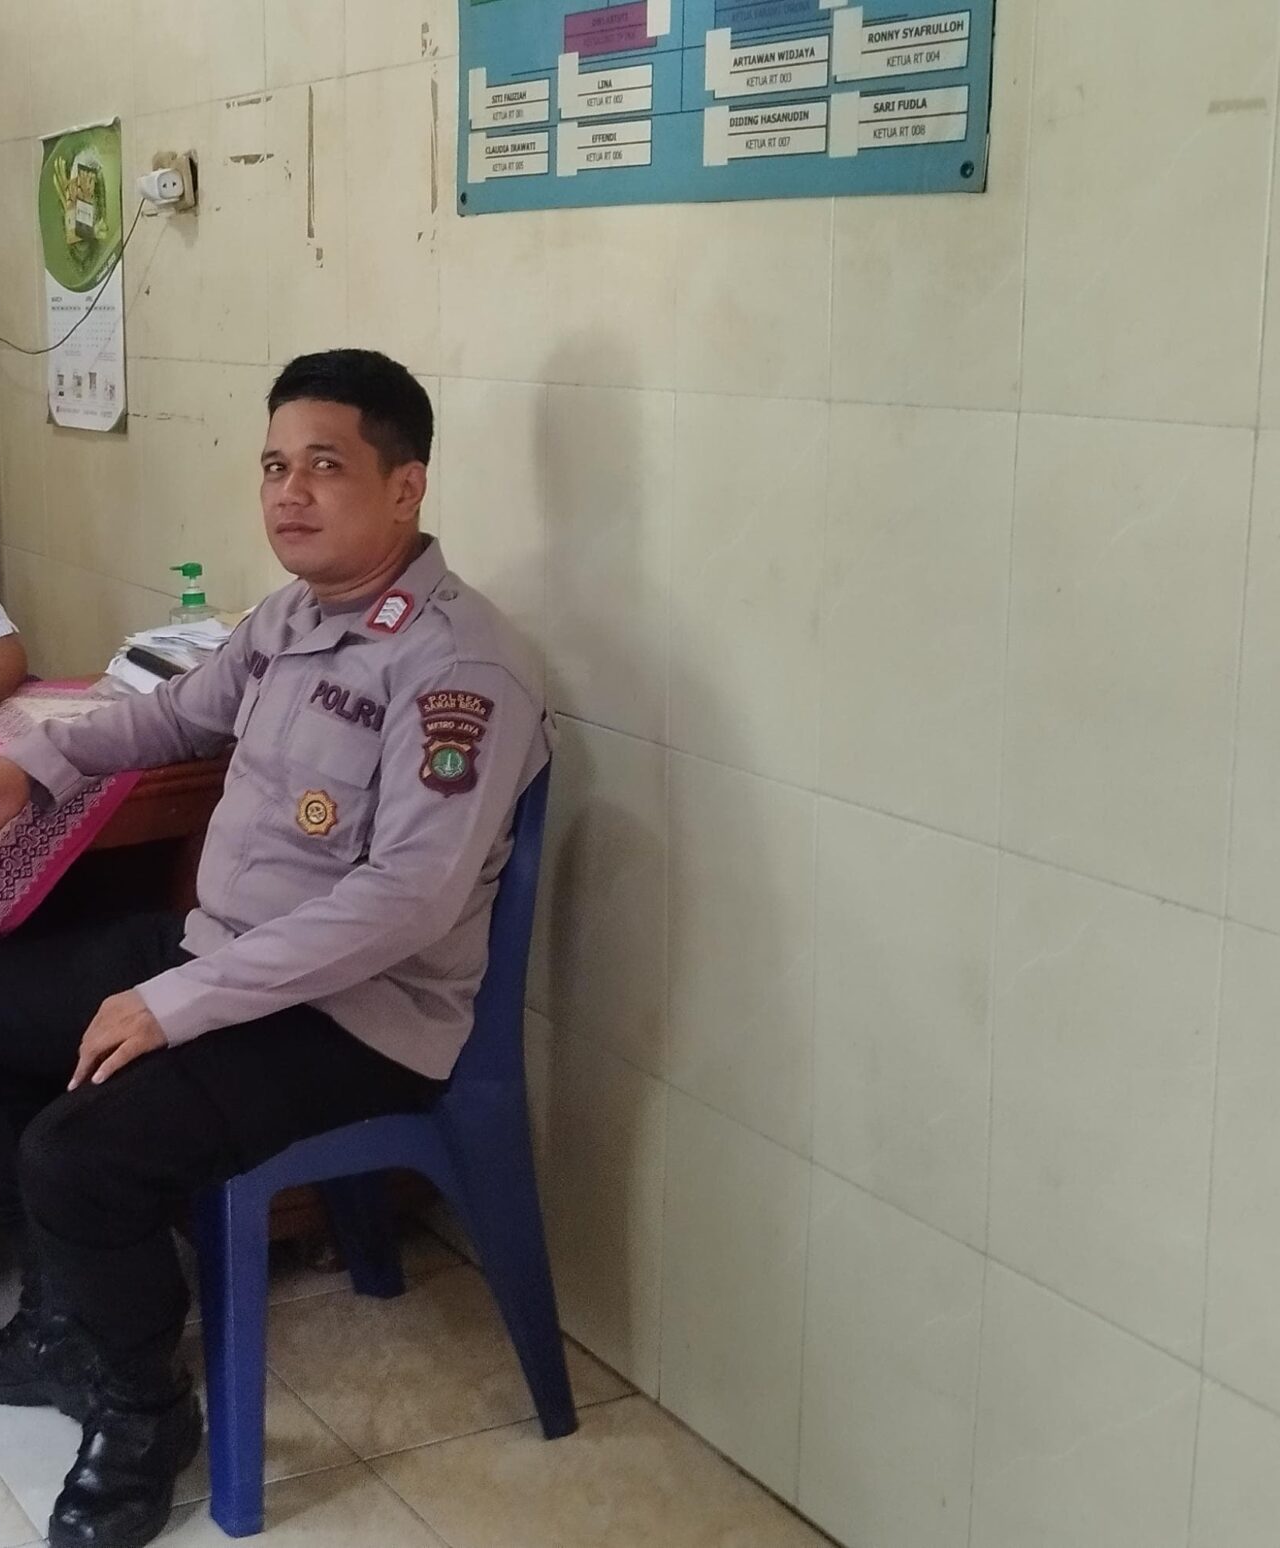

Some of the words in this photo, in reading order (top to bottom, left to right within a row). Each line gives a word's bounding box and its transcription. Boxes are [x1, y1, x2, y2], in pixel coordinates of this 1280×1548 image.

[868, 30, 899, 43] RONNY
[901, 20, 964, 39] SYAFRULLOH
[733, 52, 775, 67] ARTIAWAN
[778, 47, 815, 60] WIDJAYA
[886, 54, 912, 67] KETUA
[913, 53, 923, 63] RT
[925, 51, 940, 62] 004
[597, 79, 612, 89] LINA
[746, 75, 768, 87] KETUA
[769, 74, 778, 83] RT
[587, 97, 604, 107] KETUA
[873, 102, 895, 114] SARI
[898, 98, 927, 111] FUDLA
[729, 115, 759, 127] DIDING
[760, 110, 810, 125] HASANUDIN
[591, 132, 617, 143] EFFENDI
[873, 128, 898, 139] KETUA
[899, 126, 909, 136] RT
[745, 139, 767, 150] KETUA
[767, 138, 776, 148] RT
[586, 152, 604, 162] KETUA
[428, 693, 481, 705] POLSEK
[309, 679, 386, 733] POLRI
[426, 721, 455, 731] METRO
[458, 721, 479, 736] JAYA
